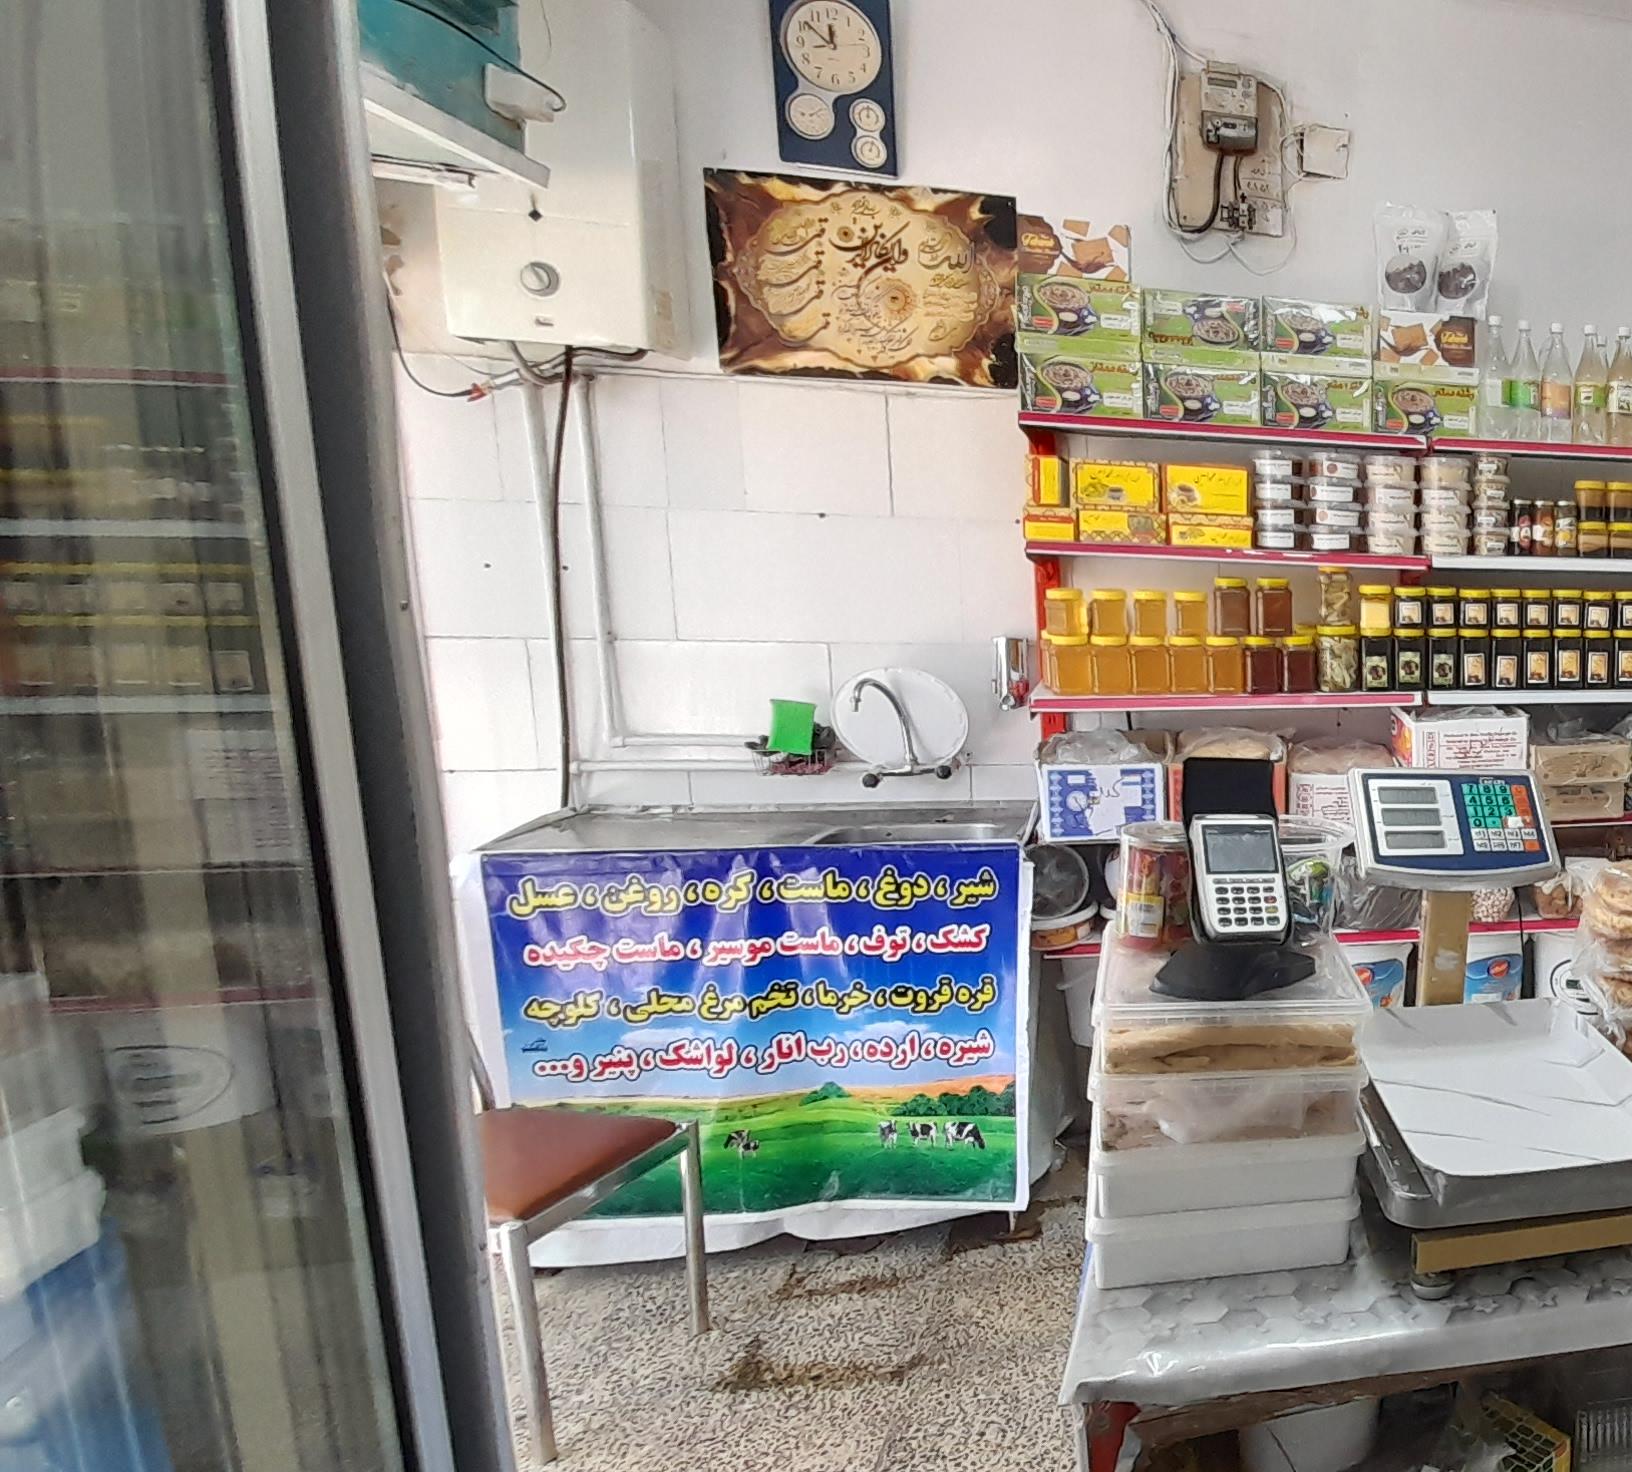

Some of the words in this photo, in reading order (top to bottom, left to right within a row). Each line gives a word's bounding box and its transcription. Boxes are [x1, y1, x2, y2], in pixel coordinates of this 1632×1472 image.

[796, 36, 805, 48] 9
[801, 52, 810, 65] 8
[813, 66, 823, 79] 7
[831, 73, 840, 86] 6
[508, 879, 578, 918] عسل
[522, 937, 611, 971] چکیده
[614, 933, 682, 966] ماست
[778, 929, 842, 956] ماست
[697, 982, 745, 1023] مرغ
[746, 984, 798, 1022] تخم
[957, 976, 996, 1012] قره
[524, 993, 603, 1028] کلوچه
[588, 1050, 641, 1082] پنیر
[810, 1042, 848, 1072] رب
